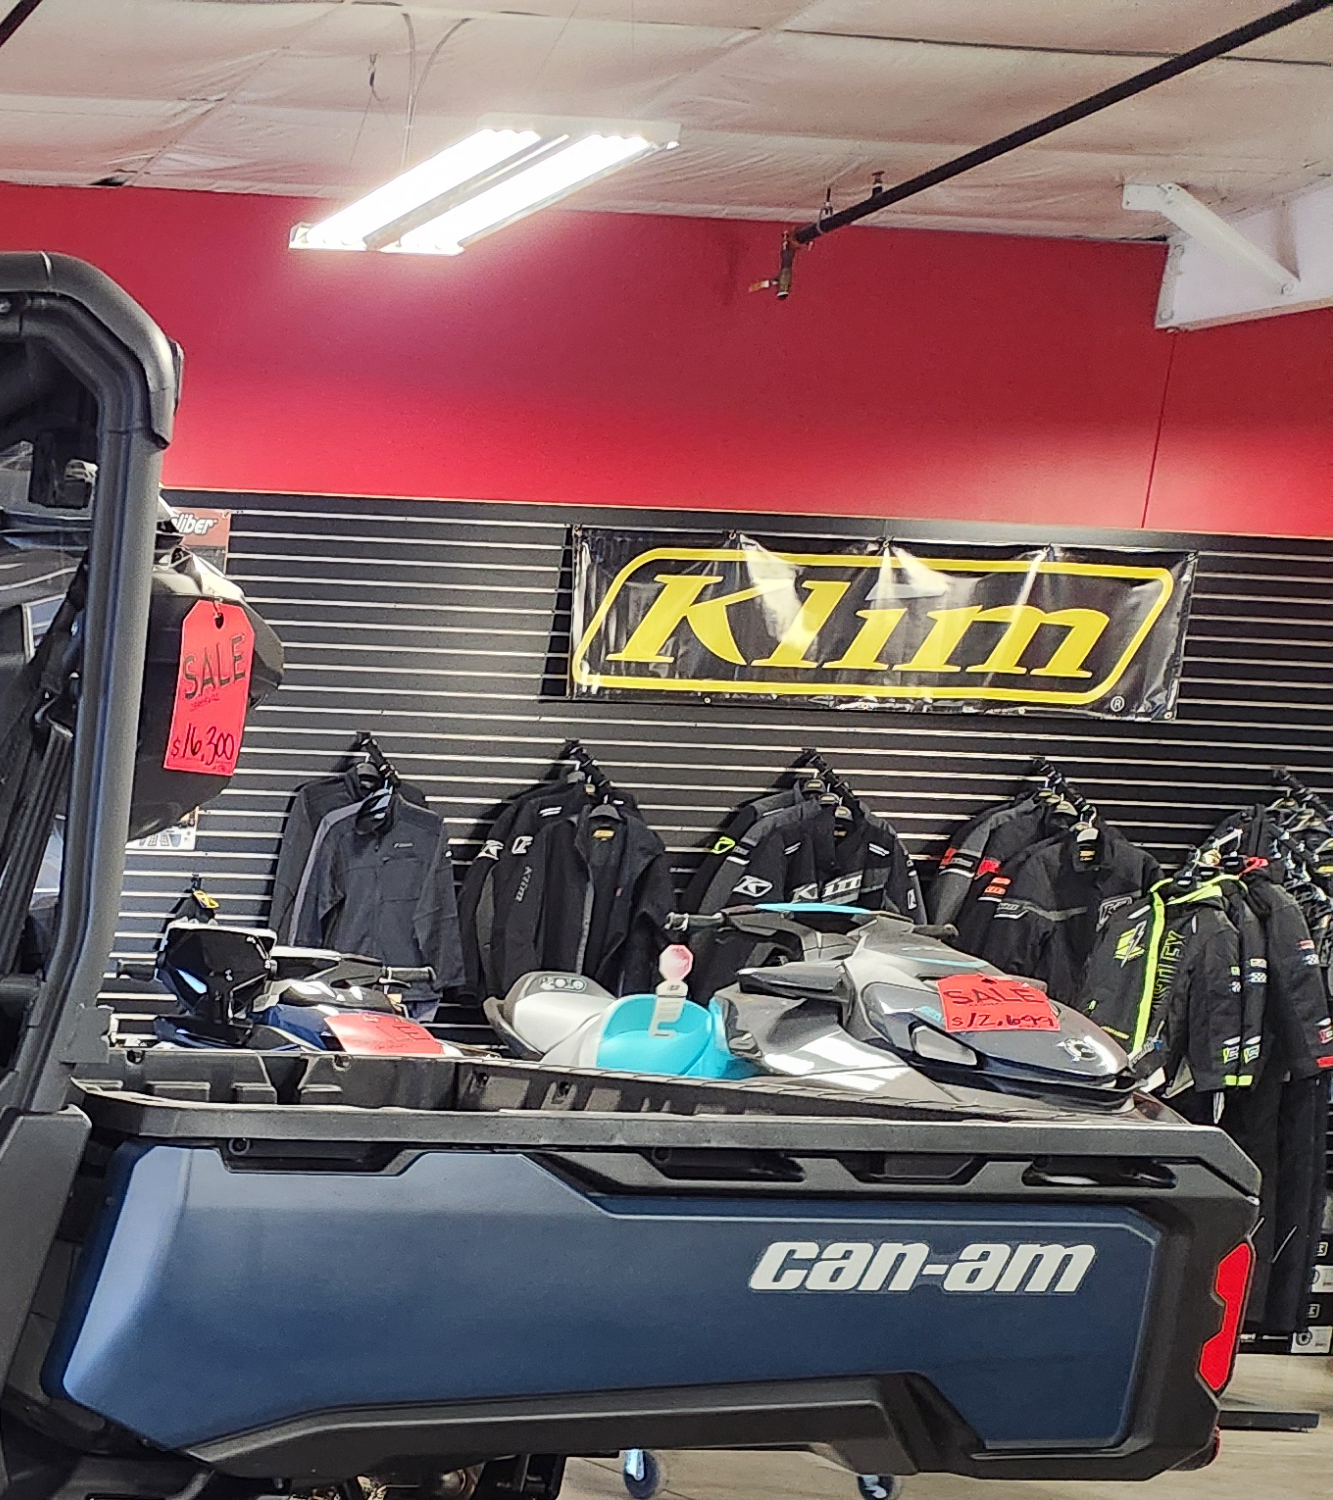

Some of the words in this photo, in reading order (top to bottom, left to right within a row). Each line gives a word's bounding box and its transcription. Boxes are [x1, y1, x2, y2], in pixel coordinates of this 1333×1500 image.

[171, 513, 217, 535] liber
[606, 575, 1110, 678] Klim
[184, 635, 246, 699] SALE
[171, 723, 235, 766] $16,300
[943, 987, 1045, 1005] SALE
[749, 1241, 1096, 1292] can-am
